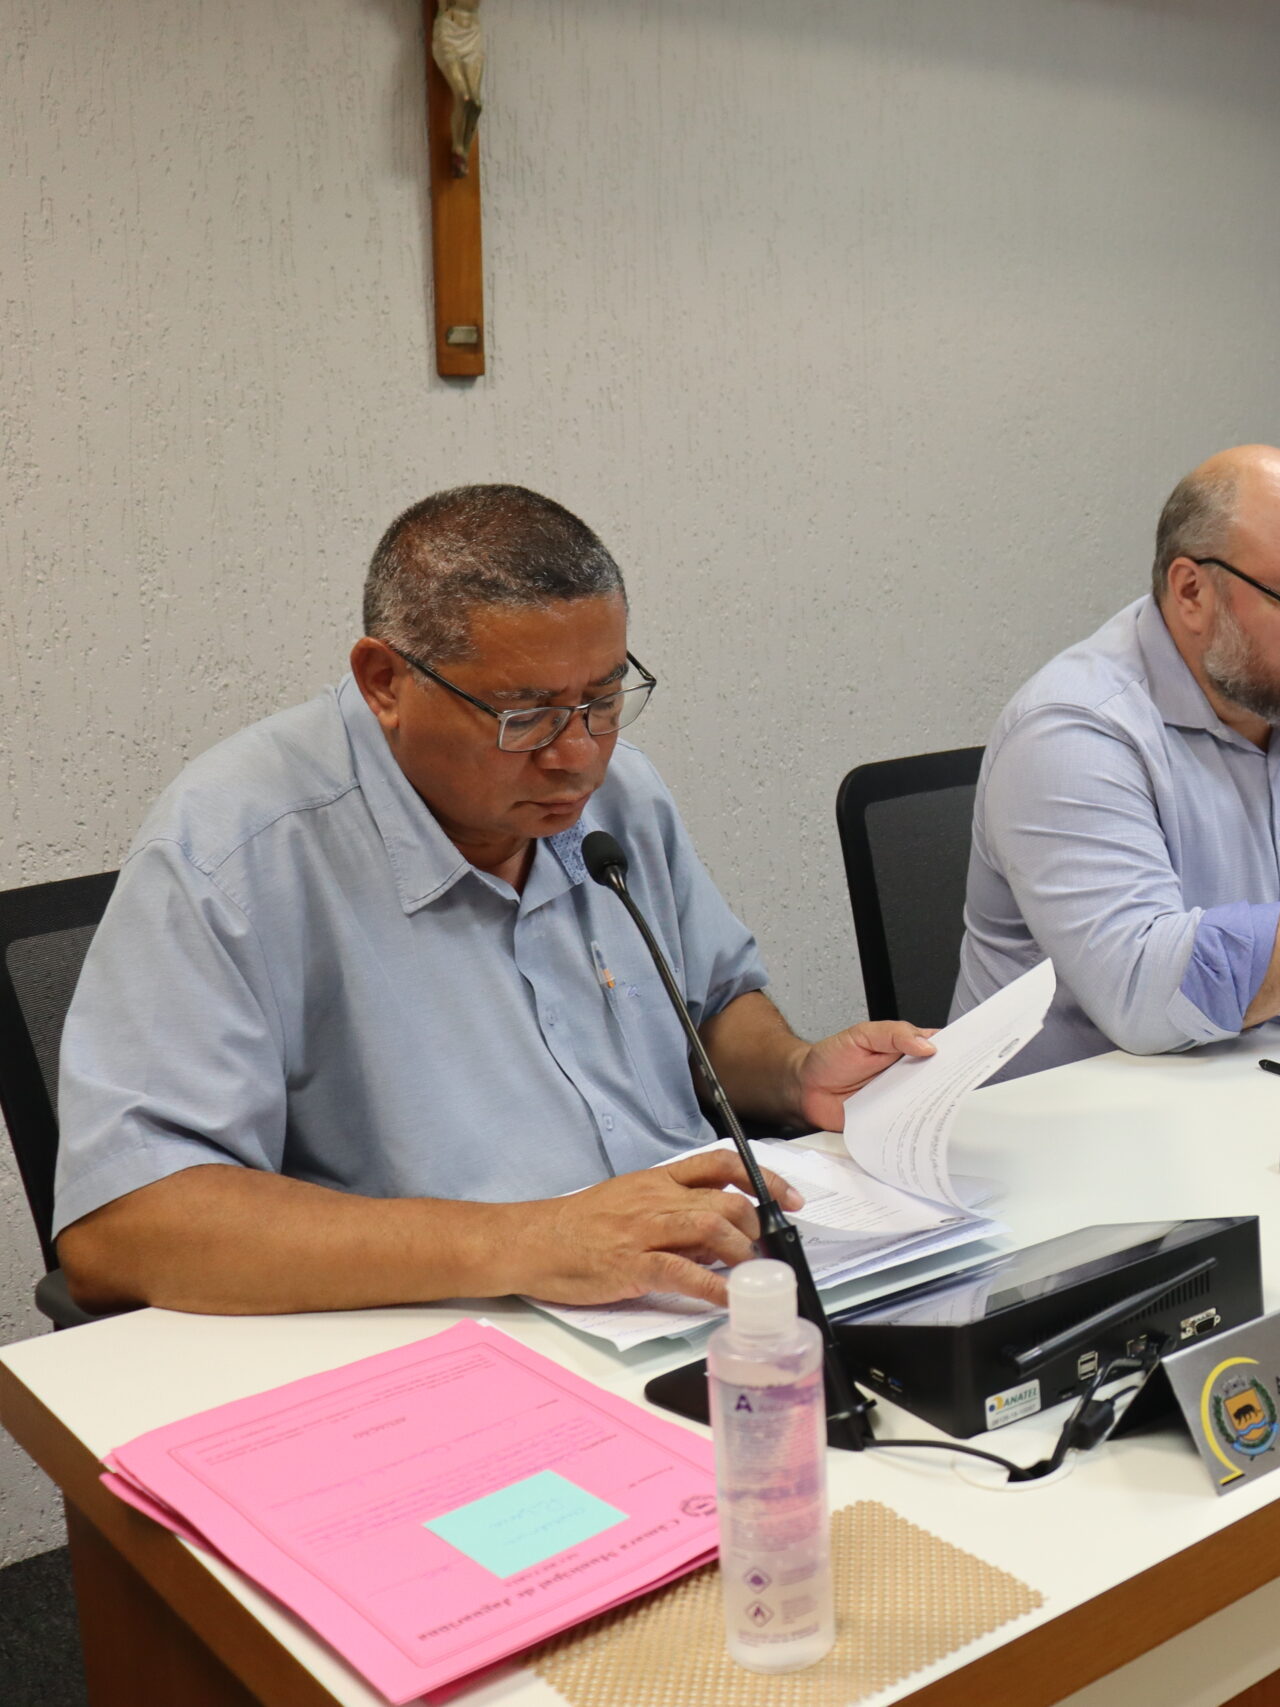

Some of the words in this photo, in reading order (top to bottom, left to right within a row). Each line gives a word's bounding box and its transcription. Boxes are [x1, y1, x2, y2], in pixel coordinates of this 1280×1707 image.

[735, 1394, 753, 1413] A
[1004, 1387, 1037, 1406] ANATEL
[538, 1551, 618, 1591] Municipal
[516, 1586, 535, 1598] de
